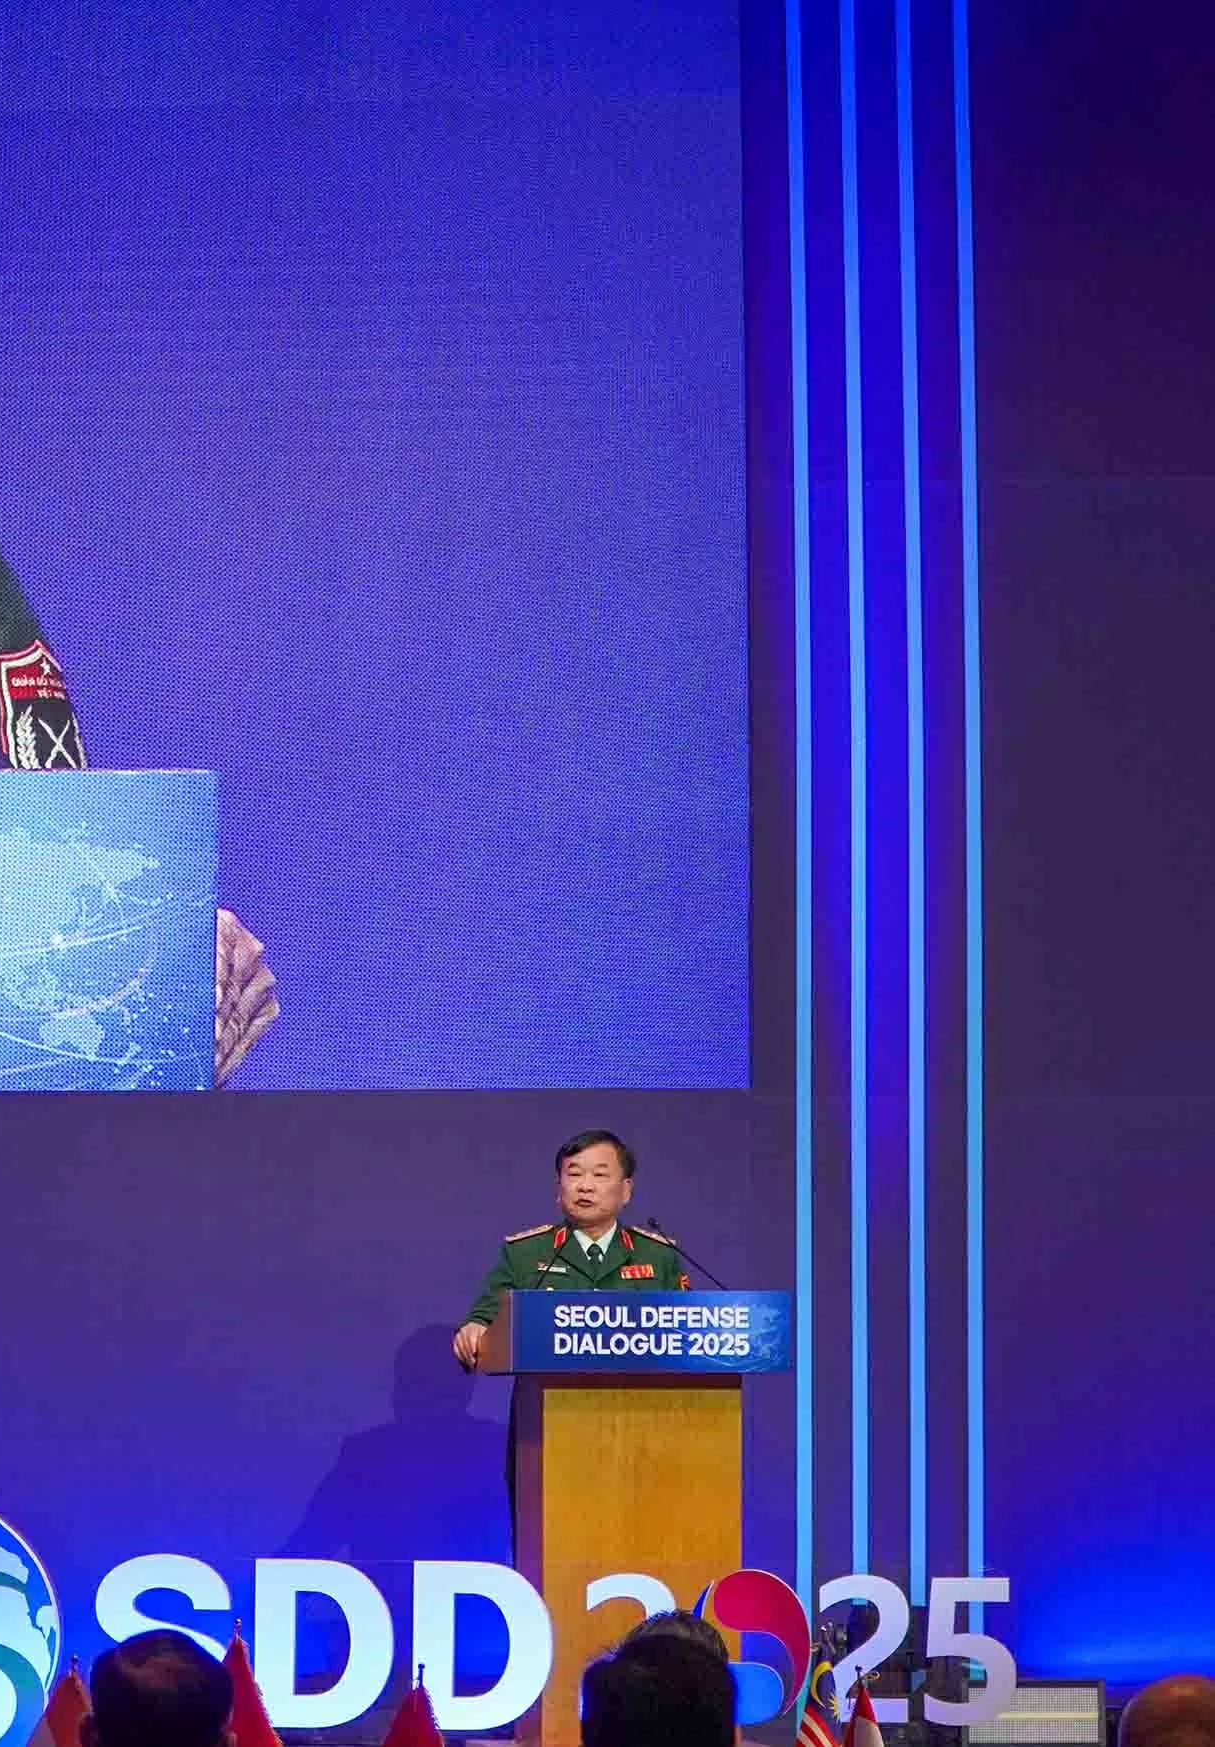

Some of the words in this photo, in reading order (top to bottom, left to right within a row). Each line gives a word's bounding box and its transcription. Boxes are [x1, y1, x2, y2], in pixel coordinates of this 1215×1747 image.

[554, 1305, 636, 1328] SEOUL
[641, 1306, 750, 1329] DEFENSE
[554, 1333, 683, 1356] DIALOGUE
[688, 1333, 750, 1356] 2025
[95, 1553, 554, 1731] SDD
